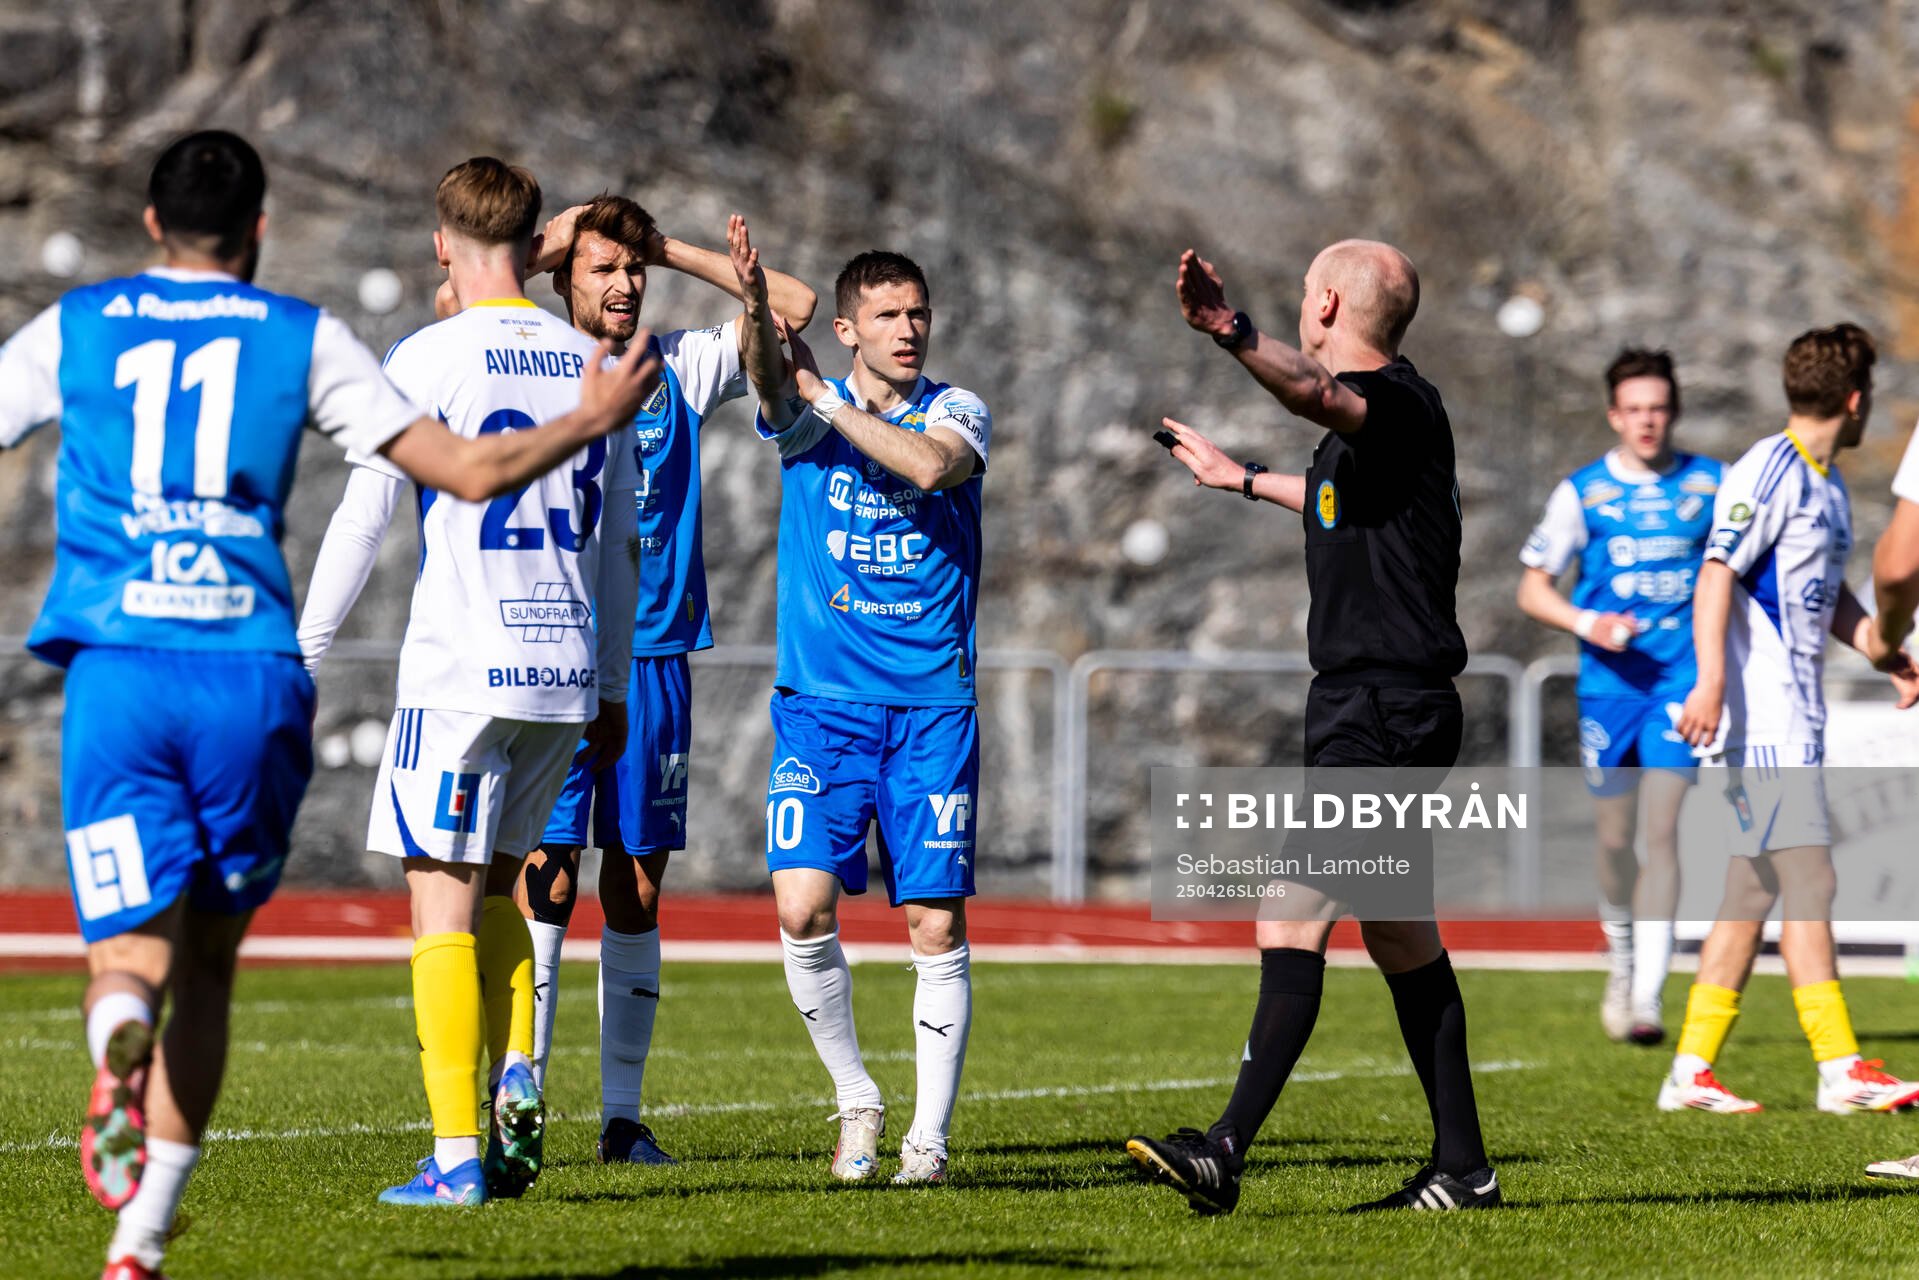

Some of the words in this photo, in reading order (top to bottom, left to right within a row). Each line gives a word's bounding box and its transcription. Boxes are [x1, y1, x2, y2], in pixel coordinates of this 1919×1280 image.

[136, 293, 269, 322] Ramudden
[485, 348, 584, 379] AVIANDER
[114, 338, 241, 498] 11
[479, 408, 606, 553] 23
[854, 502, 917, 519] GRUPPEN
[151, 540, 228, 585] ICA
[851, 533, 923, 563] EBC
[857, 563, 917, 575] GROUP
[854, 599, 922, 615] FYRSTADS
[774, 772, 810, 785] SESAB
[765, 797, 804, 853] 10
